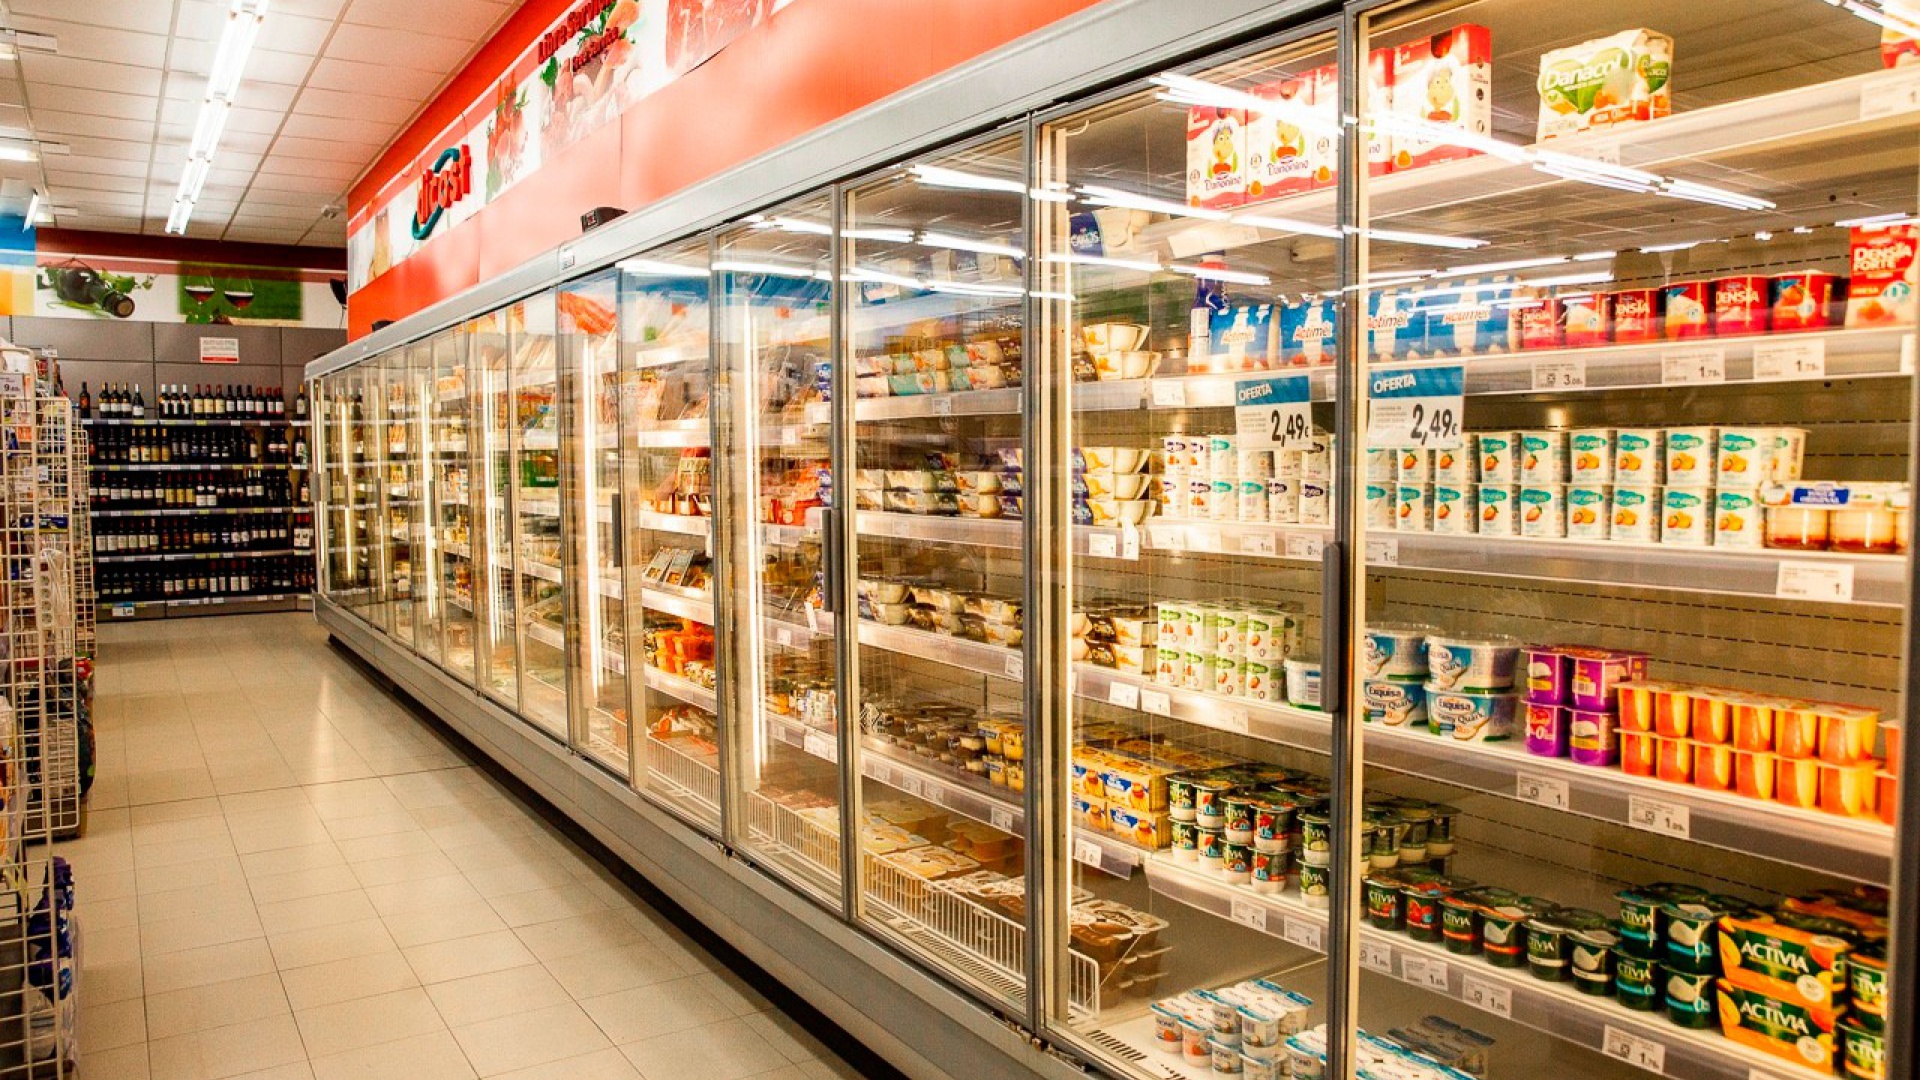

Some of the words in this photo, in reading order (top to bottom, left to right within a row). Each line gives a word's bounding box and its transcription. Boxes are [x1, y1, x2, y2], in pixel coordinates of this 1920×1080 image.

[1295, 323, 1332, 339] Actimel
[1239, 383, 1272, 400] OFERTA
[1374, 373, 1417, 393] OFERTA
[1369, 686, 1402, 697] Exquisa
[1438, 698, 1471, 711] Exquisa
[1740, 939, 1810, 974] ACTIVIA
[1740, 1000, 1810, 1035] ACTIVIA
